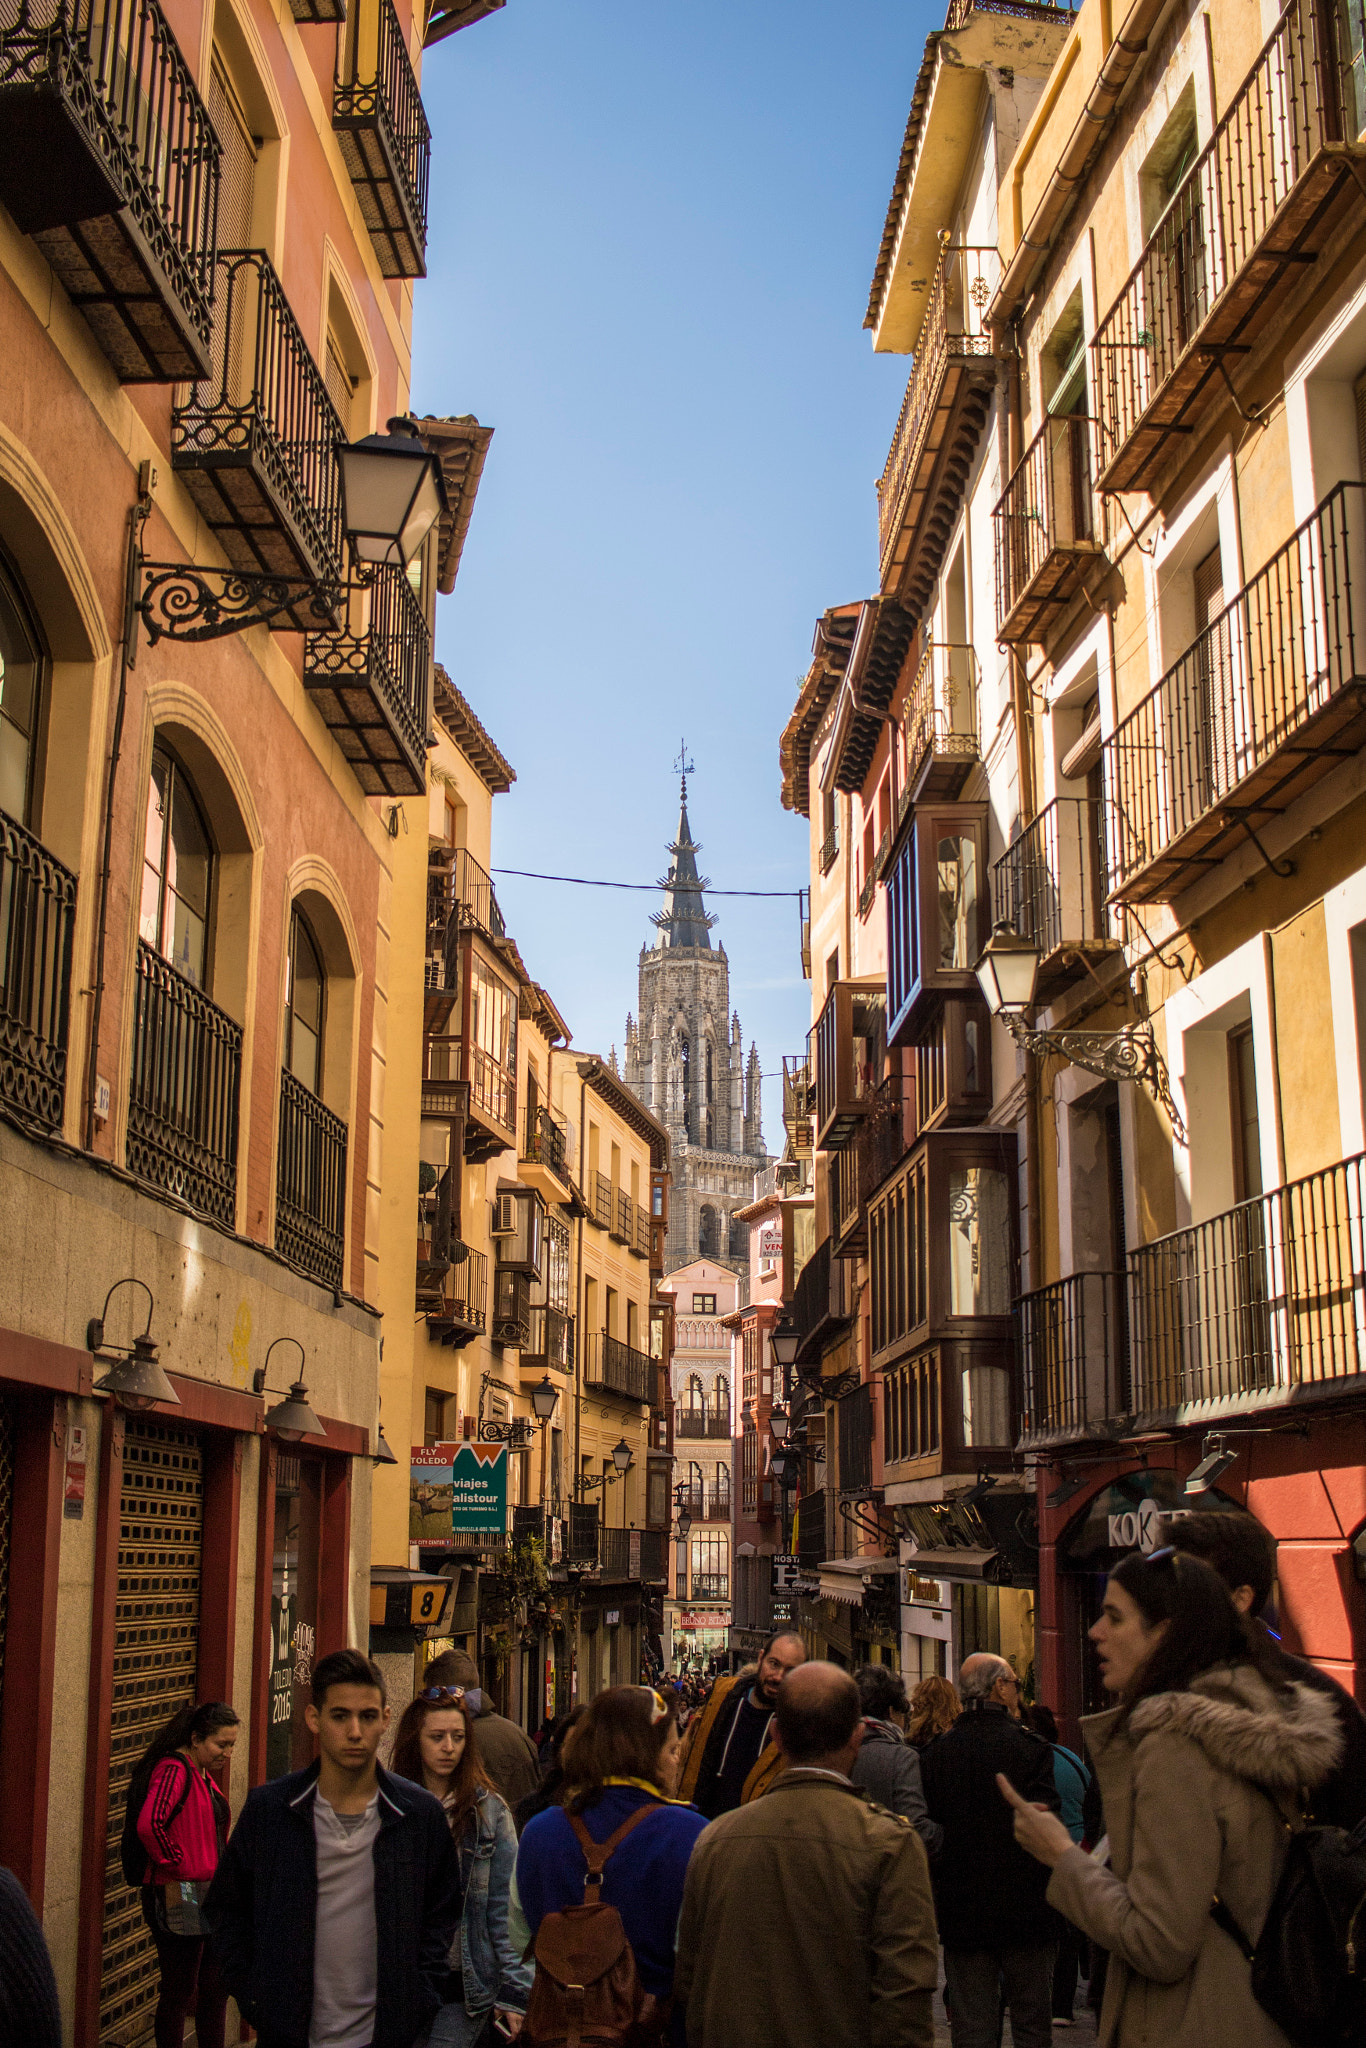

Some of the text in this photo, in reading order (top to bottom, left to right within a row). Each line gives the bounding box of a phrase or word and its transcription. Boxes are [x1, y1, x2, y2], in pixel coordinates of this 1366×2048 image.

[420, 1448, 437, 1456] FLY
[410, 1457, 448, 1465] TOLEDO
[453, 1478, 489, 1490] viajes
[420, 1591, 434, 1617] 8
[274, 1668, 292, 1690] TOLEDO
[273, 1691, 291, 1724] 2016
